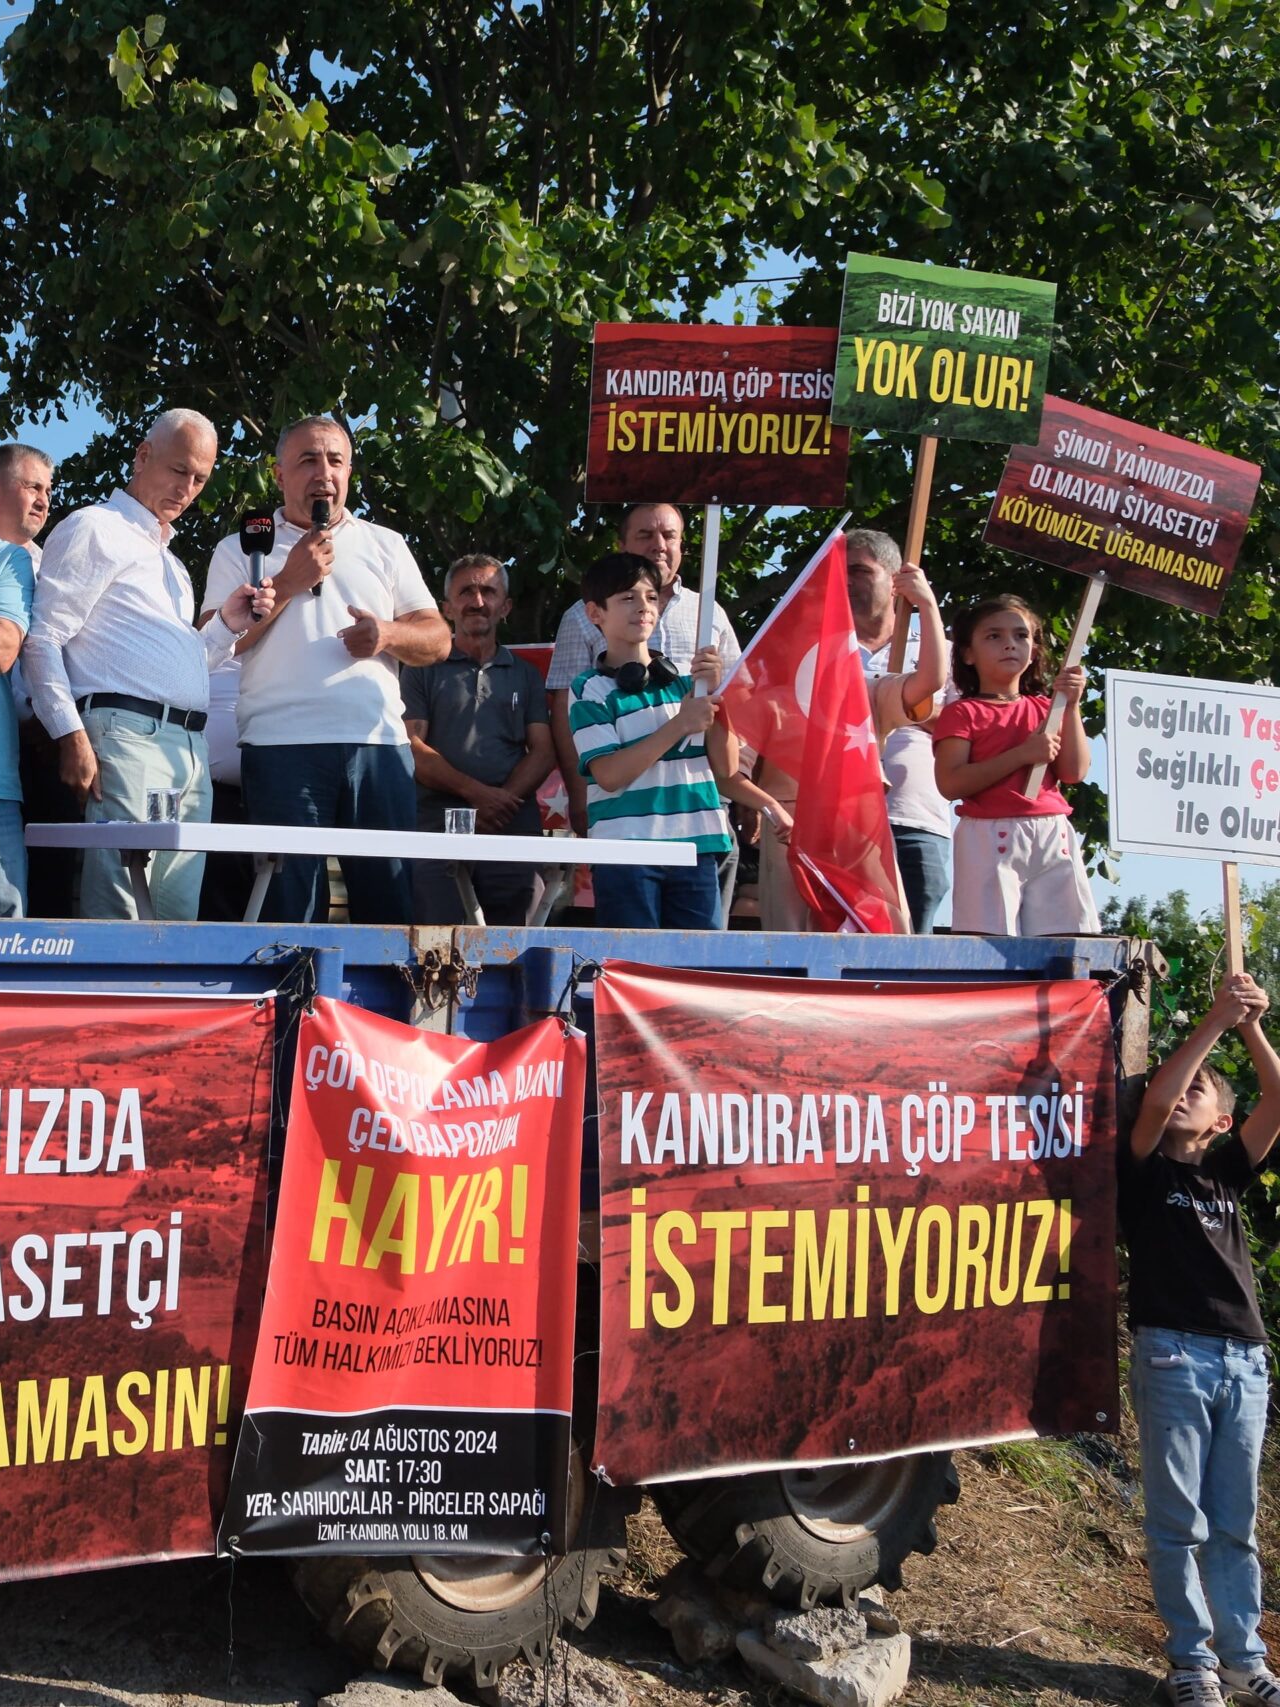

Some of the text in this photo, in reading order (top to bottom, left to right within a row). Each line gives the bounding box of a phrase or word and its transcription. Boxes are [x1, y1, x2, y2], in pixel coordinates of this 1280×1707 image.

[877, 288, 1020, 340] BİZİ YOK SAYAN
[733, 366, 773, 403] ÇÖP
[779, 368, 834, 400] TESİS
[854, 336, 1034, 413] YOK OLUR!
[607, 402, 832, 456] İSTEMİYORUZ!
[1054, 428, 1216, 504] ŞİMDİ YANIMIZDA
[1029, 463, 1220, 548] OLMAYAN SİYASETÇİ
[997, 495, 1225, 590] KÖYÜMÜZE UĞRAMASIN!
[1127, 695, 1231, 739] Sağlıklı
[1136, 747, 1240, 791] Sağlıklı
[1175, 800, 1209, 836] ile
[305, 1040, 366, 1092] ÇÖP
[513, 1060, 564, 1103] ALANI
[348, 1107, 521, 1159] ÇED RAPORUNA
[900, 1081, 975, 1177] ÇÖP
[985, 1081, 1084, 1161] TESİSİ
[309, 1158, 529, 1275] HAYIR!
[629, 1185, 1073, 1330] İSTEMİYORUZ!
[312, 1296, 511, 1338] BASIN AÇIKLAMASINA
[274, 1331, 543, 1373] TÜM HALKIMIZI BEKLİYORUZ!
[301, 1424, 498, 1455] TARİH: 04 AĞUSTOS 2024
[344, 1459, 442, 1484] SAAT: 17:30
[245, 1492, 277, 1517] YER:
[281, 1491, 393, 1516] SARIHOCALAR
[408, 1487, 485, 1515] PİRCELER
[488, 1489, 546, 1516] SAPAĞI
[317, 1521, 468, 1541] İZMİT-KANDIRA YOLU 18. KM
